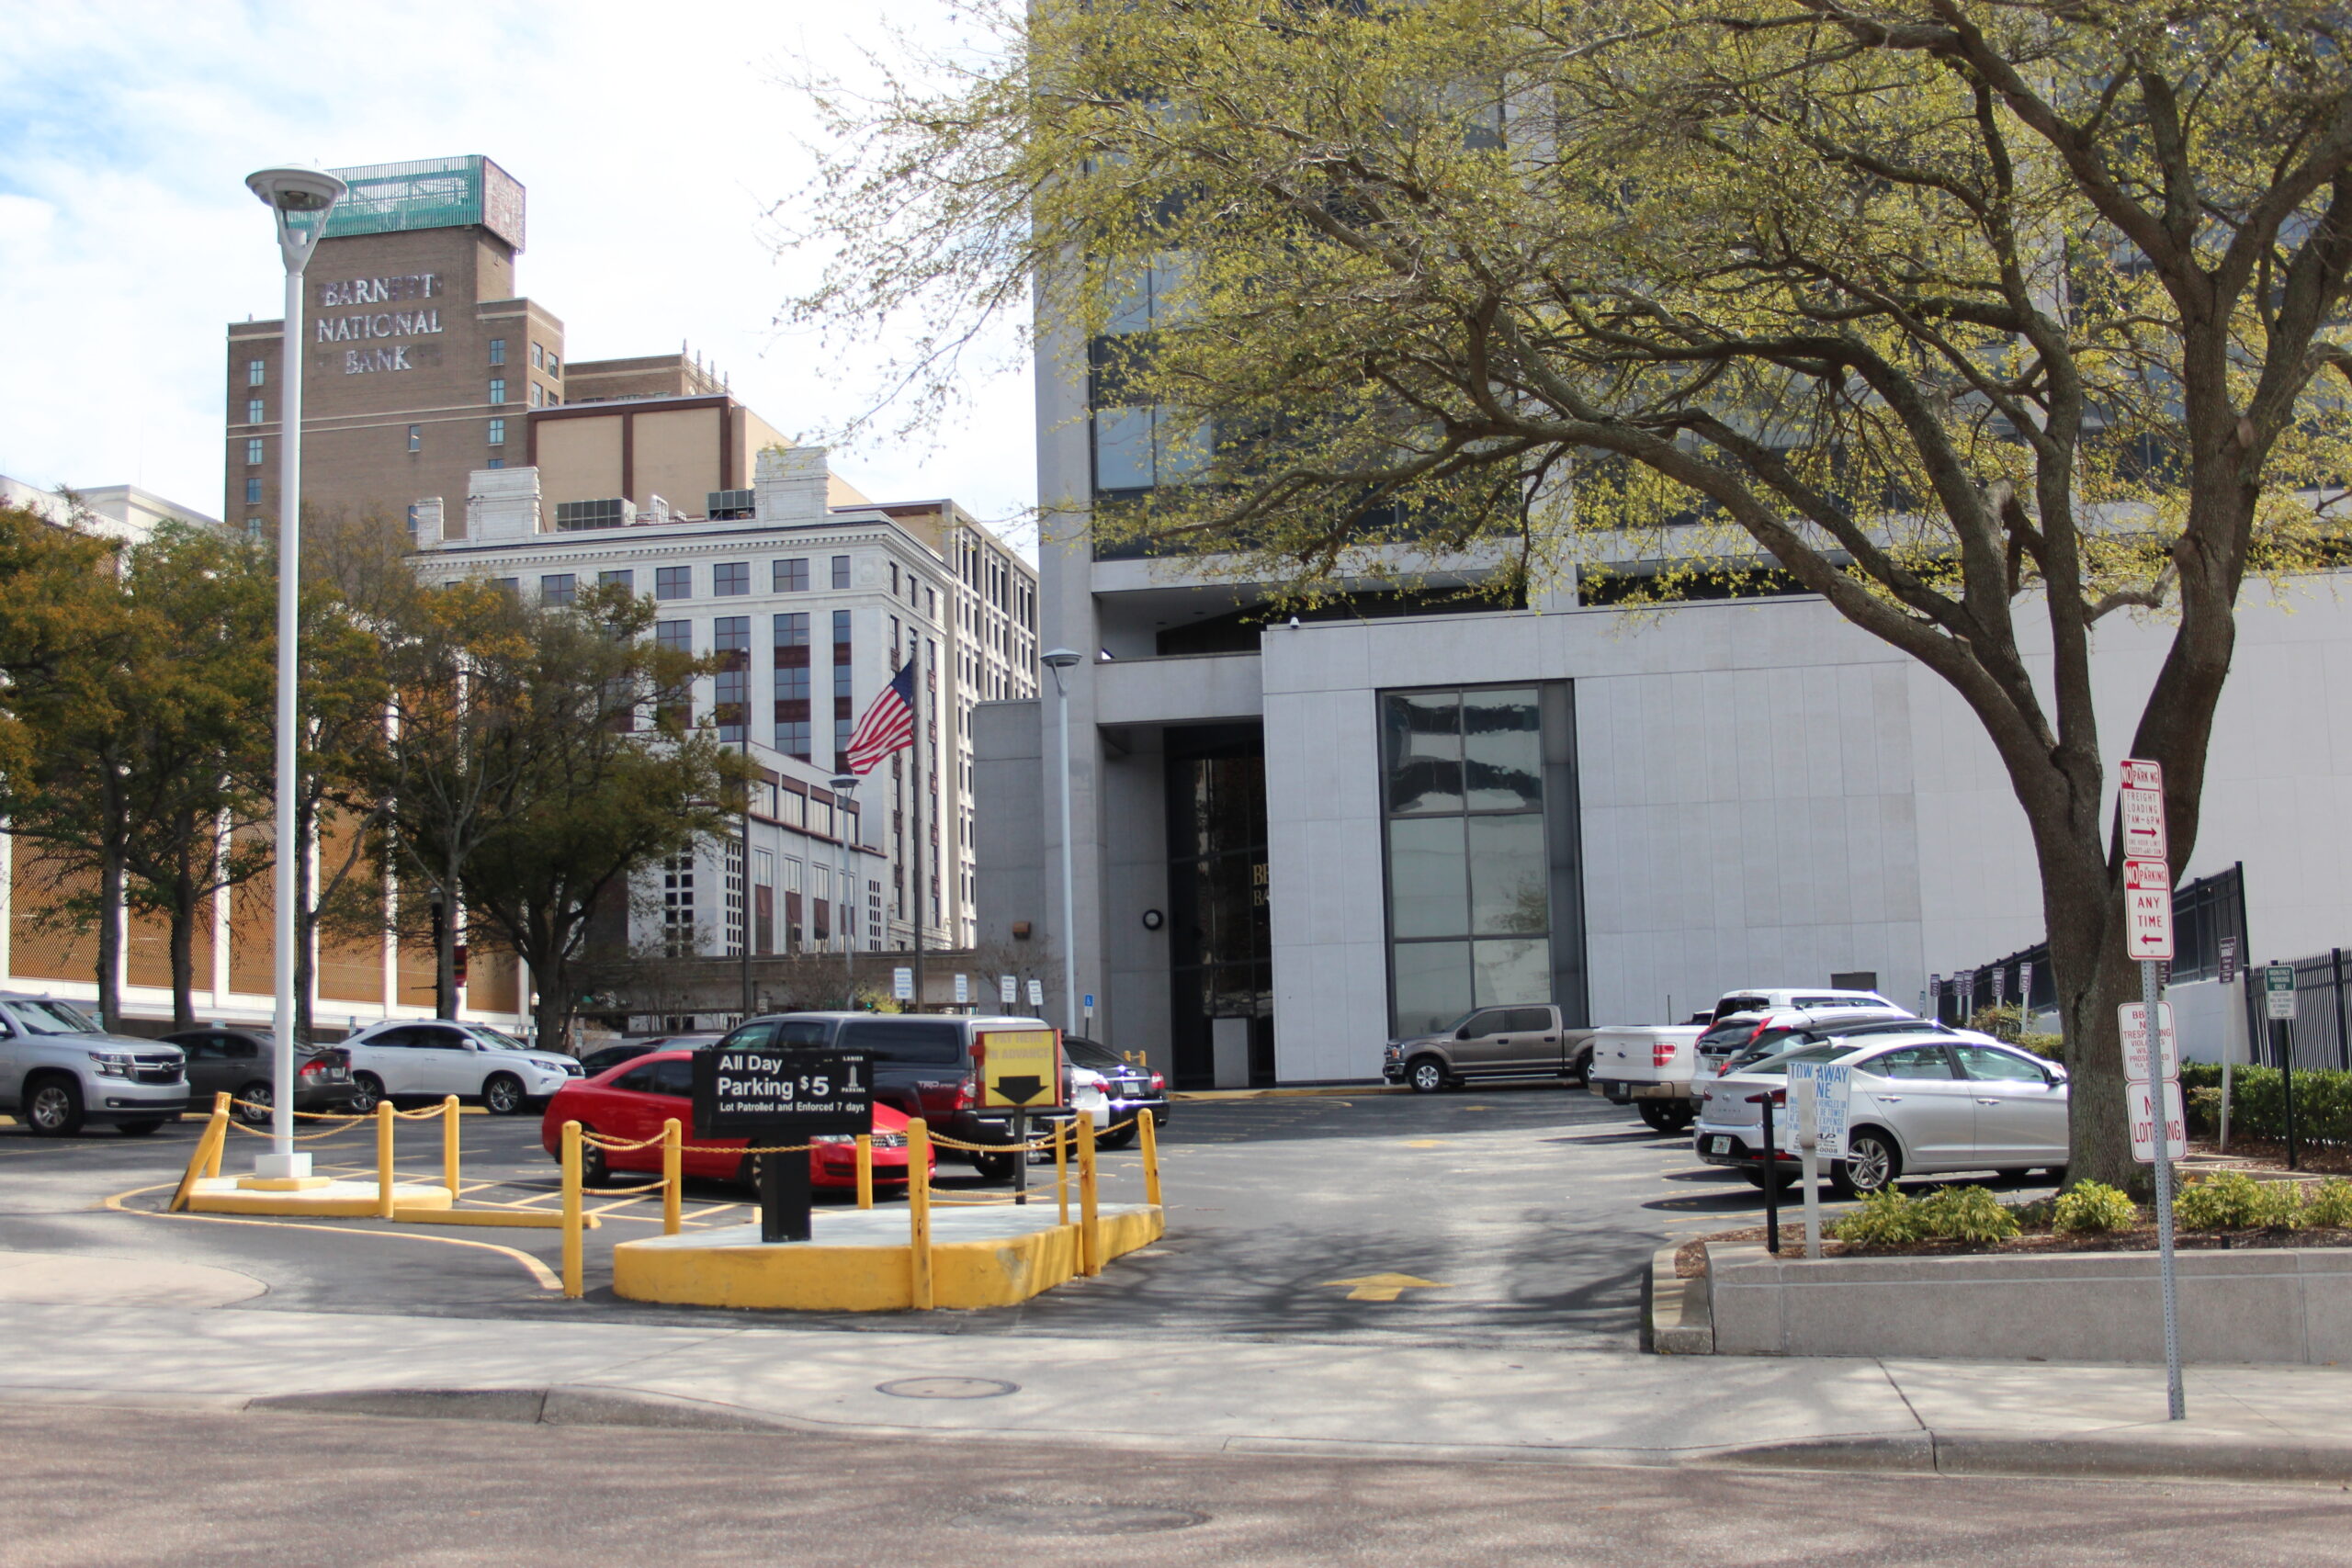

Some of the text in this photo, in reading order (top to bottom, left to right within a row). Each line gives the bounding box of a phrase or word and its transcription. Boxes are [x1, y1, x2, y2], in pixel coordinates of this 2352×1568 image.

[323, 274, 435, 307] BARNT
[317, 310, 443, 344] NATIONAL
[345, 345, 413, 375] BANK
[2120, 766, 2159, 784] NO PARKNG
[2127, 791, 2156, 802] FREIGHT
[2127, 803, 2158, 814] LOADING
[2125, 865, 2166, 885] NO PARKING
[2137, 897, 2160, 908] ANY
[2137, 915, 2163, 928] TIME
[993, 1034, 1012, 1043] PAY
[2123, 1029, 2172, 1039] TRESPING
[2131, 1038, 2165, 1047] VIOLS
[2130, 1054, 2170, 1062] PROSEED
[718, 1055, 783, 1075] All Day
[718, 1076, 830, 1100] Parking $5
[720, 1101, 735, 1112] Lot
[737, 1101, 775, 1112] Patrolled
[777, 1101, 794, 1112] and
[797, 1101, 834, 1112] Enforced
[846, 1102, 865, 1114] days
[2133, 1120, 2181, 1144] LOITING
